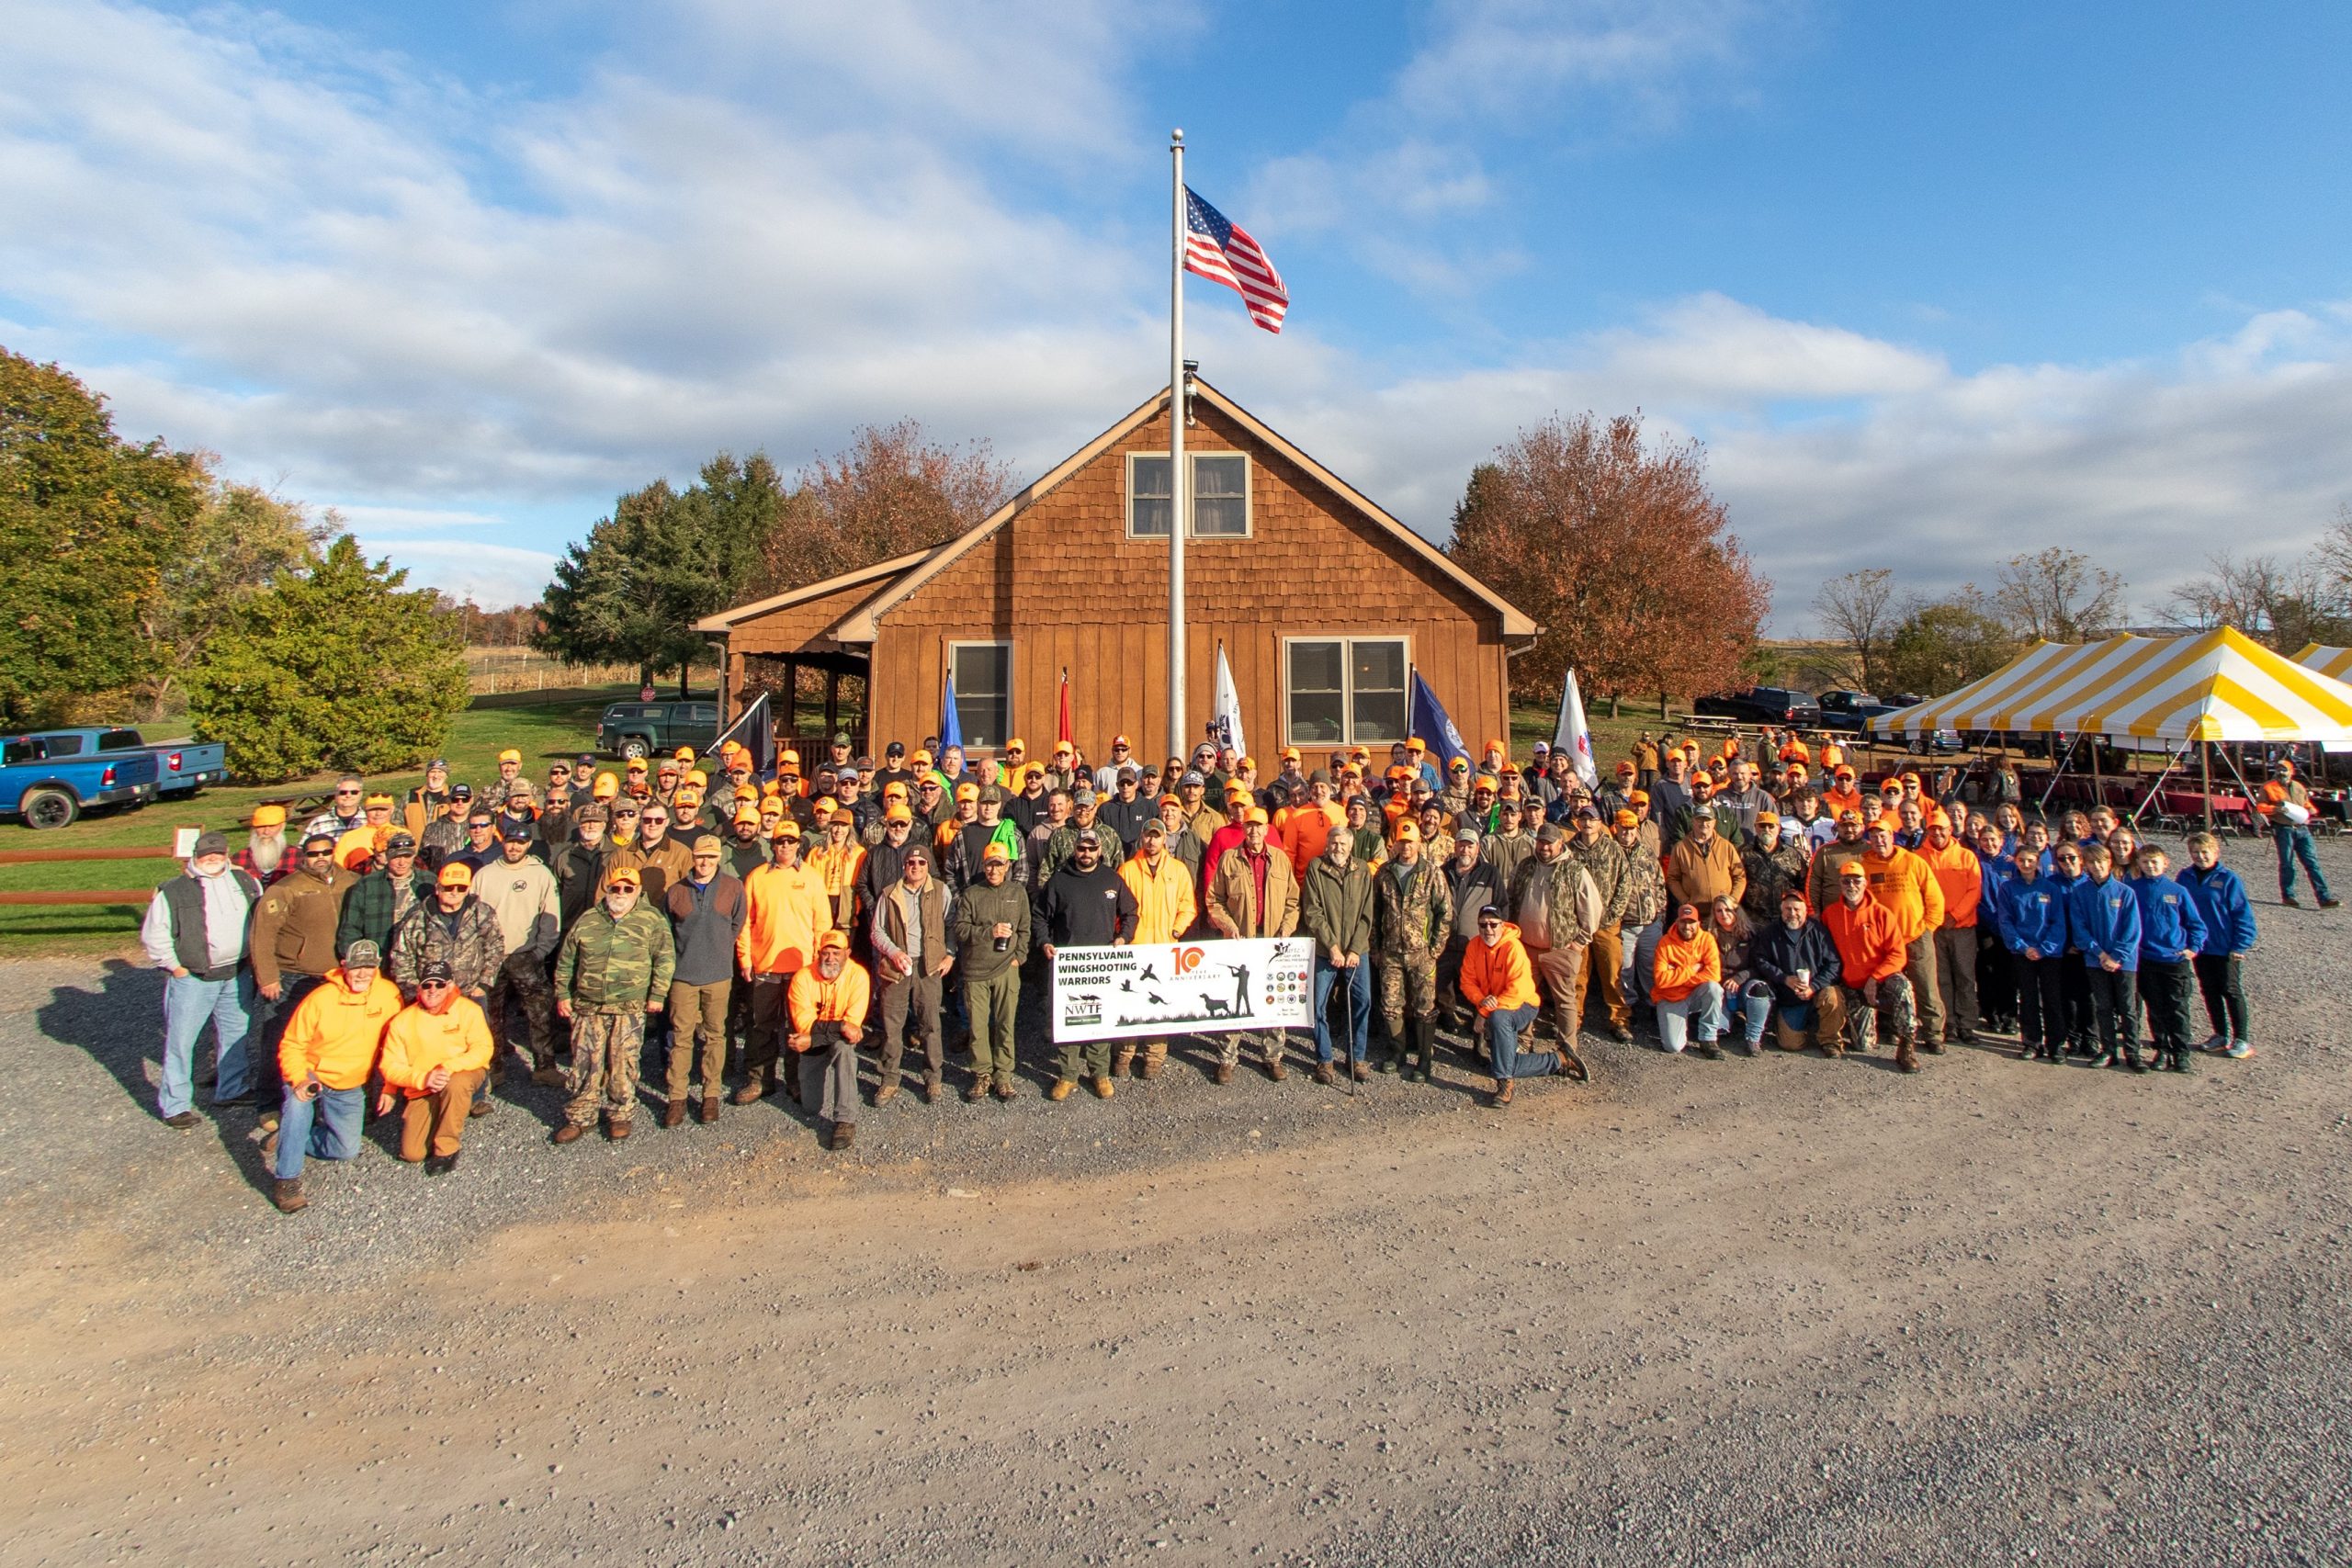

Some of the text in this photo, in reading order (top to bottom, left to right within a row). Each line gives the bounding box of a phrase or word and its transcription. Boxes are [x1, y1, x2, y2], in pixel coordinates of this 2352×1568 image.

[1058, 951, 1134, 961] PENNSYLVANIA
[1170, 947, 1205, 976] 10
[1058, 963, 1137, 974] WINGSHOOTING
[1058, 976, 1112, 986] WARRIORS
[1066, 1004, 1102, 1015] NWTF
